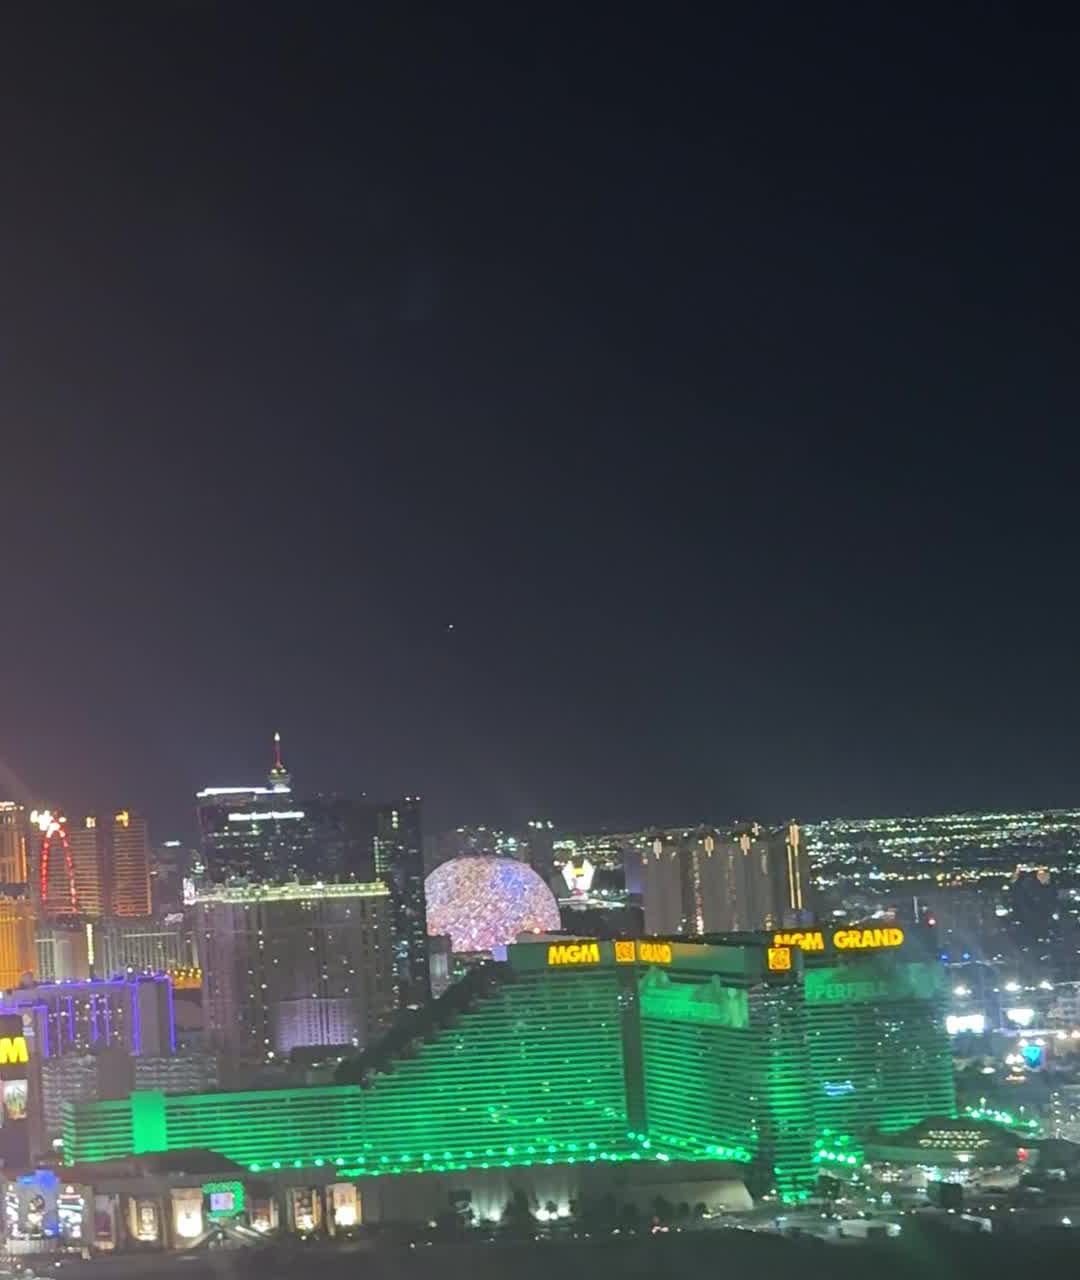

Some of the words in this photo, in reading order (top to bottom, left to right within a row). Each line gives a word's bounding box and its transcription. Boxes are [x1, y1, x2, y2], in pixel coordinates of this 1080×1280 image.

[774, 932, 824, 950] MGM
[833, 928, 904, 949] GRAND
[548, 943, 599, 964] MGM
